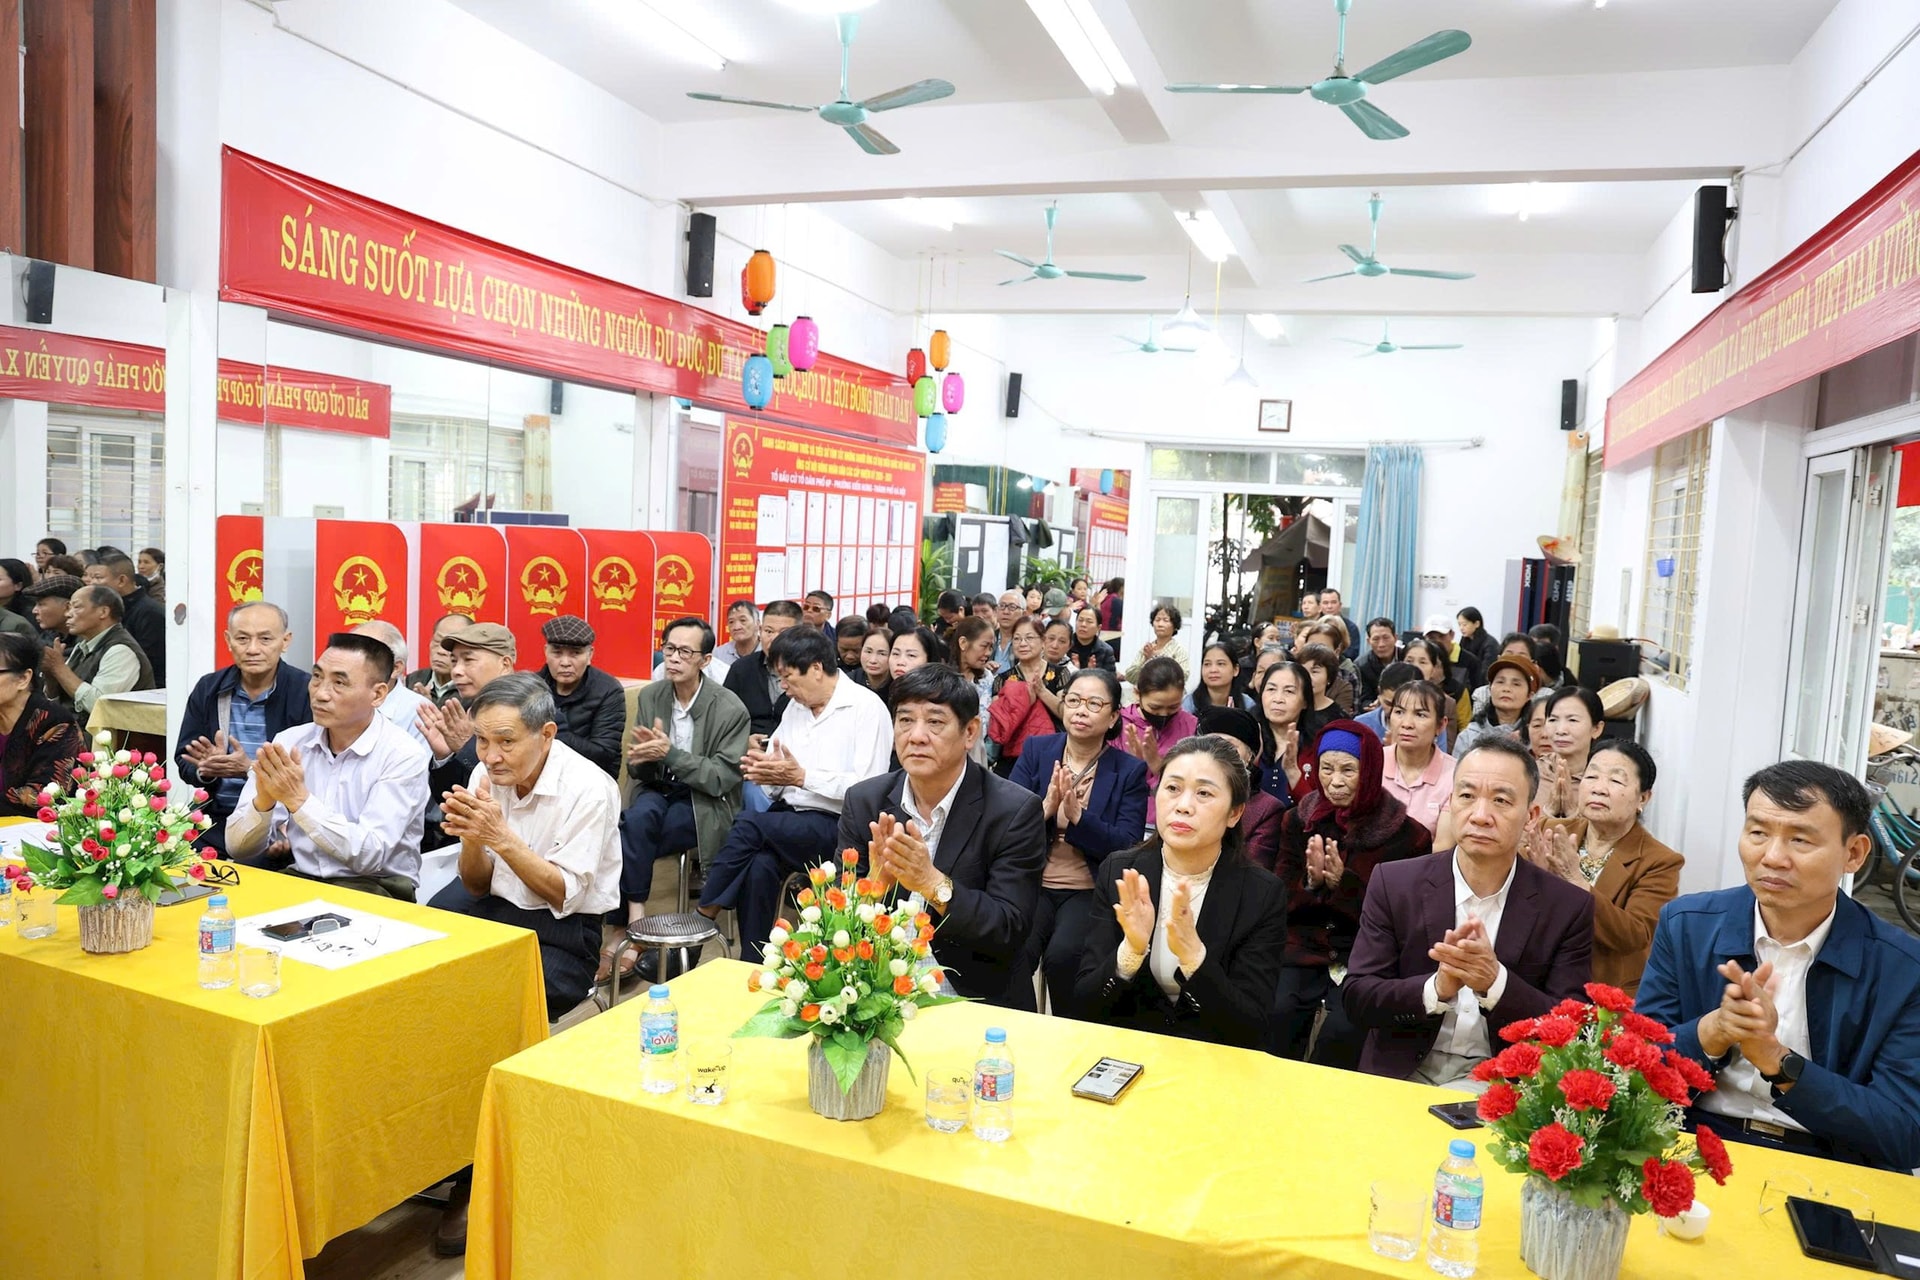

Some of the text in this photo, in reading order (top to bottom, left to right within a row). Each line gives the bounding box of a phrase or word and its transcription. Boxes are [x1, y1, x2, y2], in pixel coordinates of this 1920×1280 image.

[281, 204, 359, 285] SÁNG
[364, 229, 429, 303] SUỐT
[433, 260, 476, 324] LỰA
[481, 275, 536, 338] CHỌN
[604, 307, 653, 359] NGƯỜI
[655, 312, 675, 366] ĐỦ
[677, 322, 705, 379] ĐỨC,
[707, 328, 725, 377] ĐỦ
[820, 369, 832, 399] VÀ
[834, 370, 849, 414] HỘI
[849, 371, 873, 414] ĐỒNG
[1813, 247, 1847, 342] VIỆT
[1843, 235, 1882, 316] NAM
